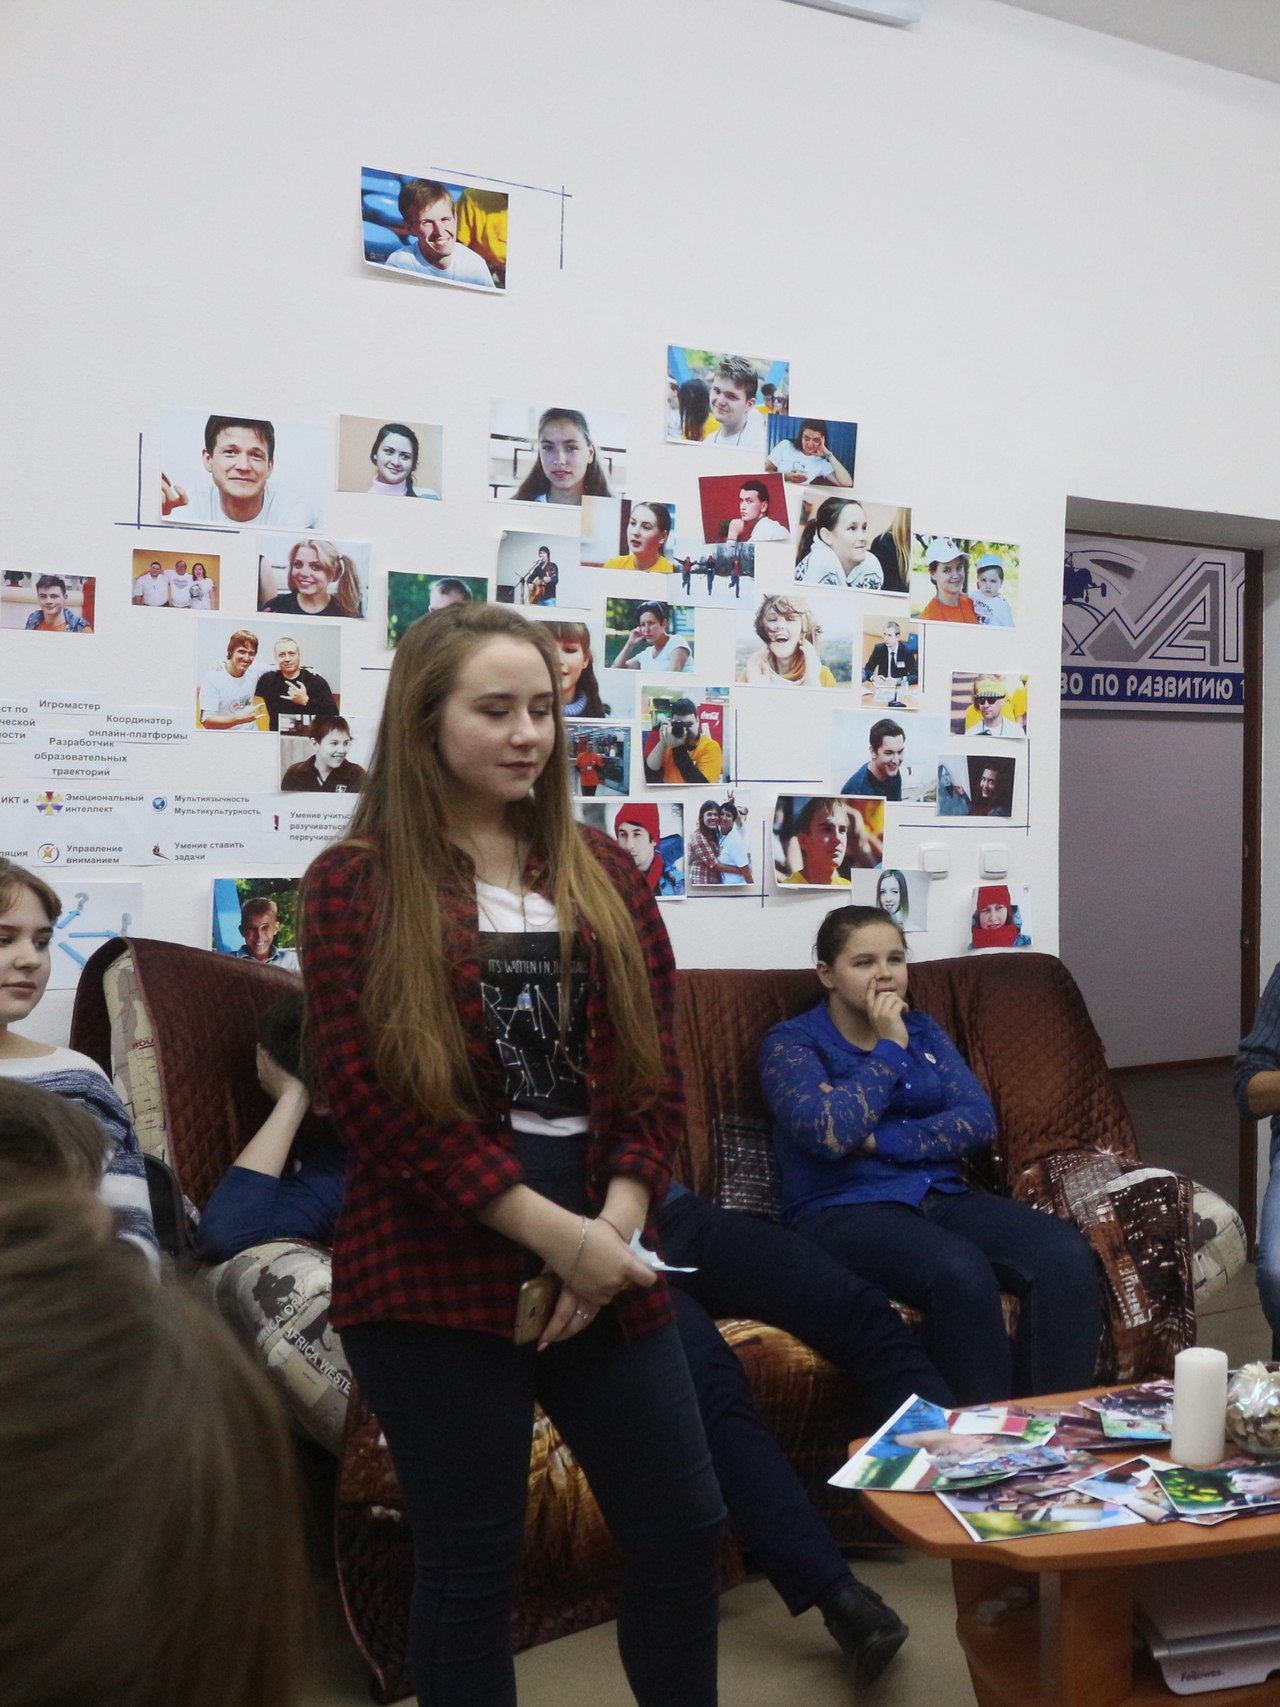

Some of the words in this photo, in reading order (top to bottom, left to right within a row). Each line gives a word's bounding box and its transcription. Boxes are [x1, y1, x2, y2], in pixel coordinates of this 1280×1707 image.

[1091, 673, 1119, 696] ПО
[1126, 674, 1233, 699] РАЗВИТИЮ
[15, 706, 28, 714] по
[39, 700, 101, 711] Игромастер
[106, 715, 173, 726] Координатор
[88, 729, 188, 741] онлайн-платформы
[49, 737, 115, 749] Разработчик
[34, 752, 128, 763] образовательных
[52, 767, 111, 777] траекторий
[1, 796, 20, 804] ИКТ
[65, 793, 144, 802] Эмоциональный
[174, 795, 250, 803] Мультиязычность
[174, 808, 261, 816] Мультикультурность
[290, 812, 321, 820] Умение
[67, 845, 123, 853] Управление
[319, 1358, 352, 1398] WESTE
